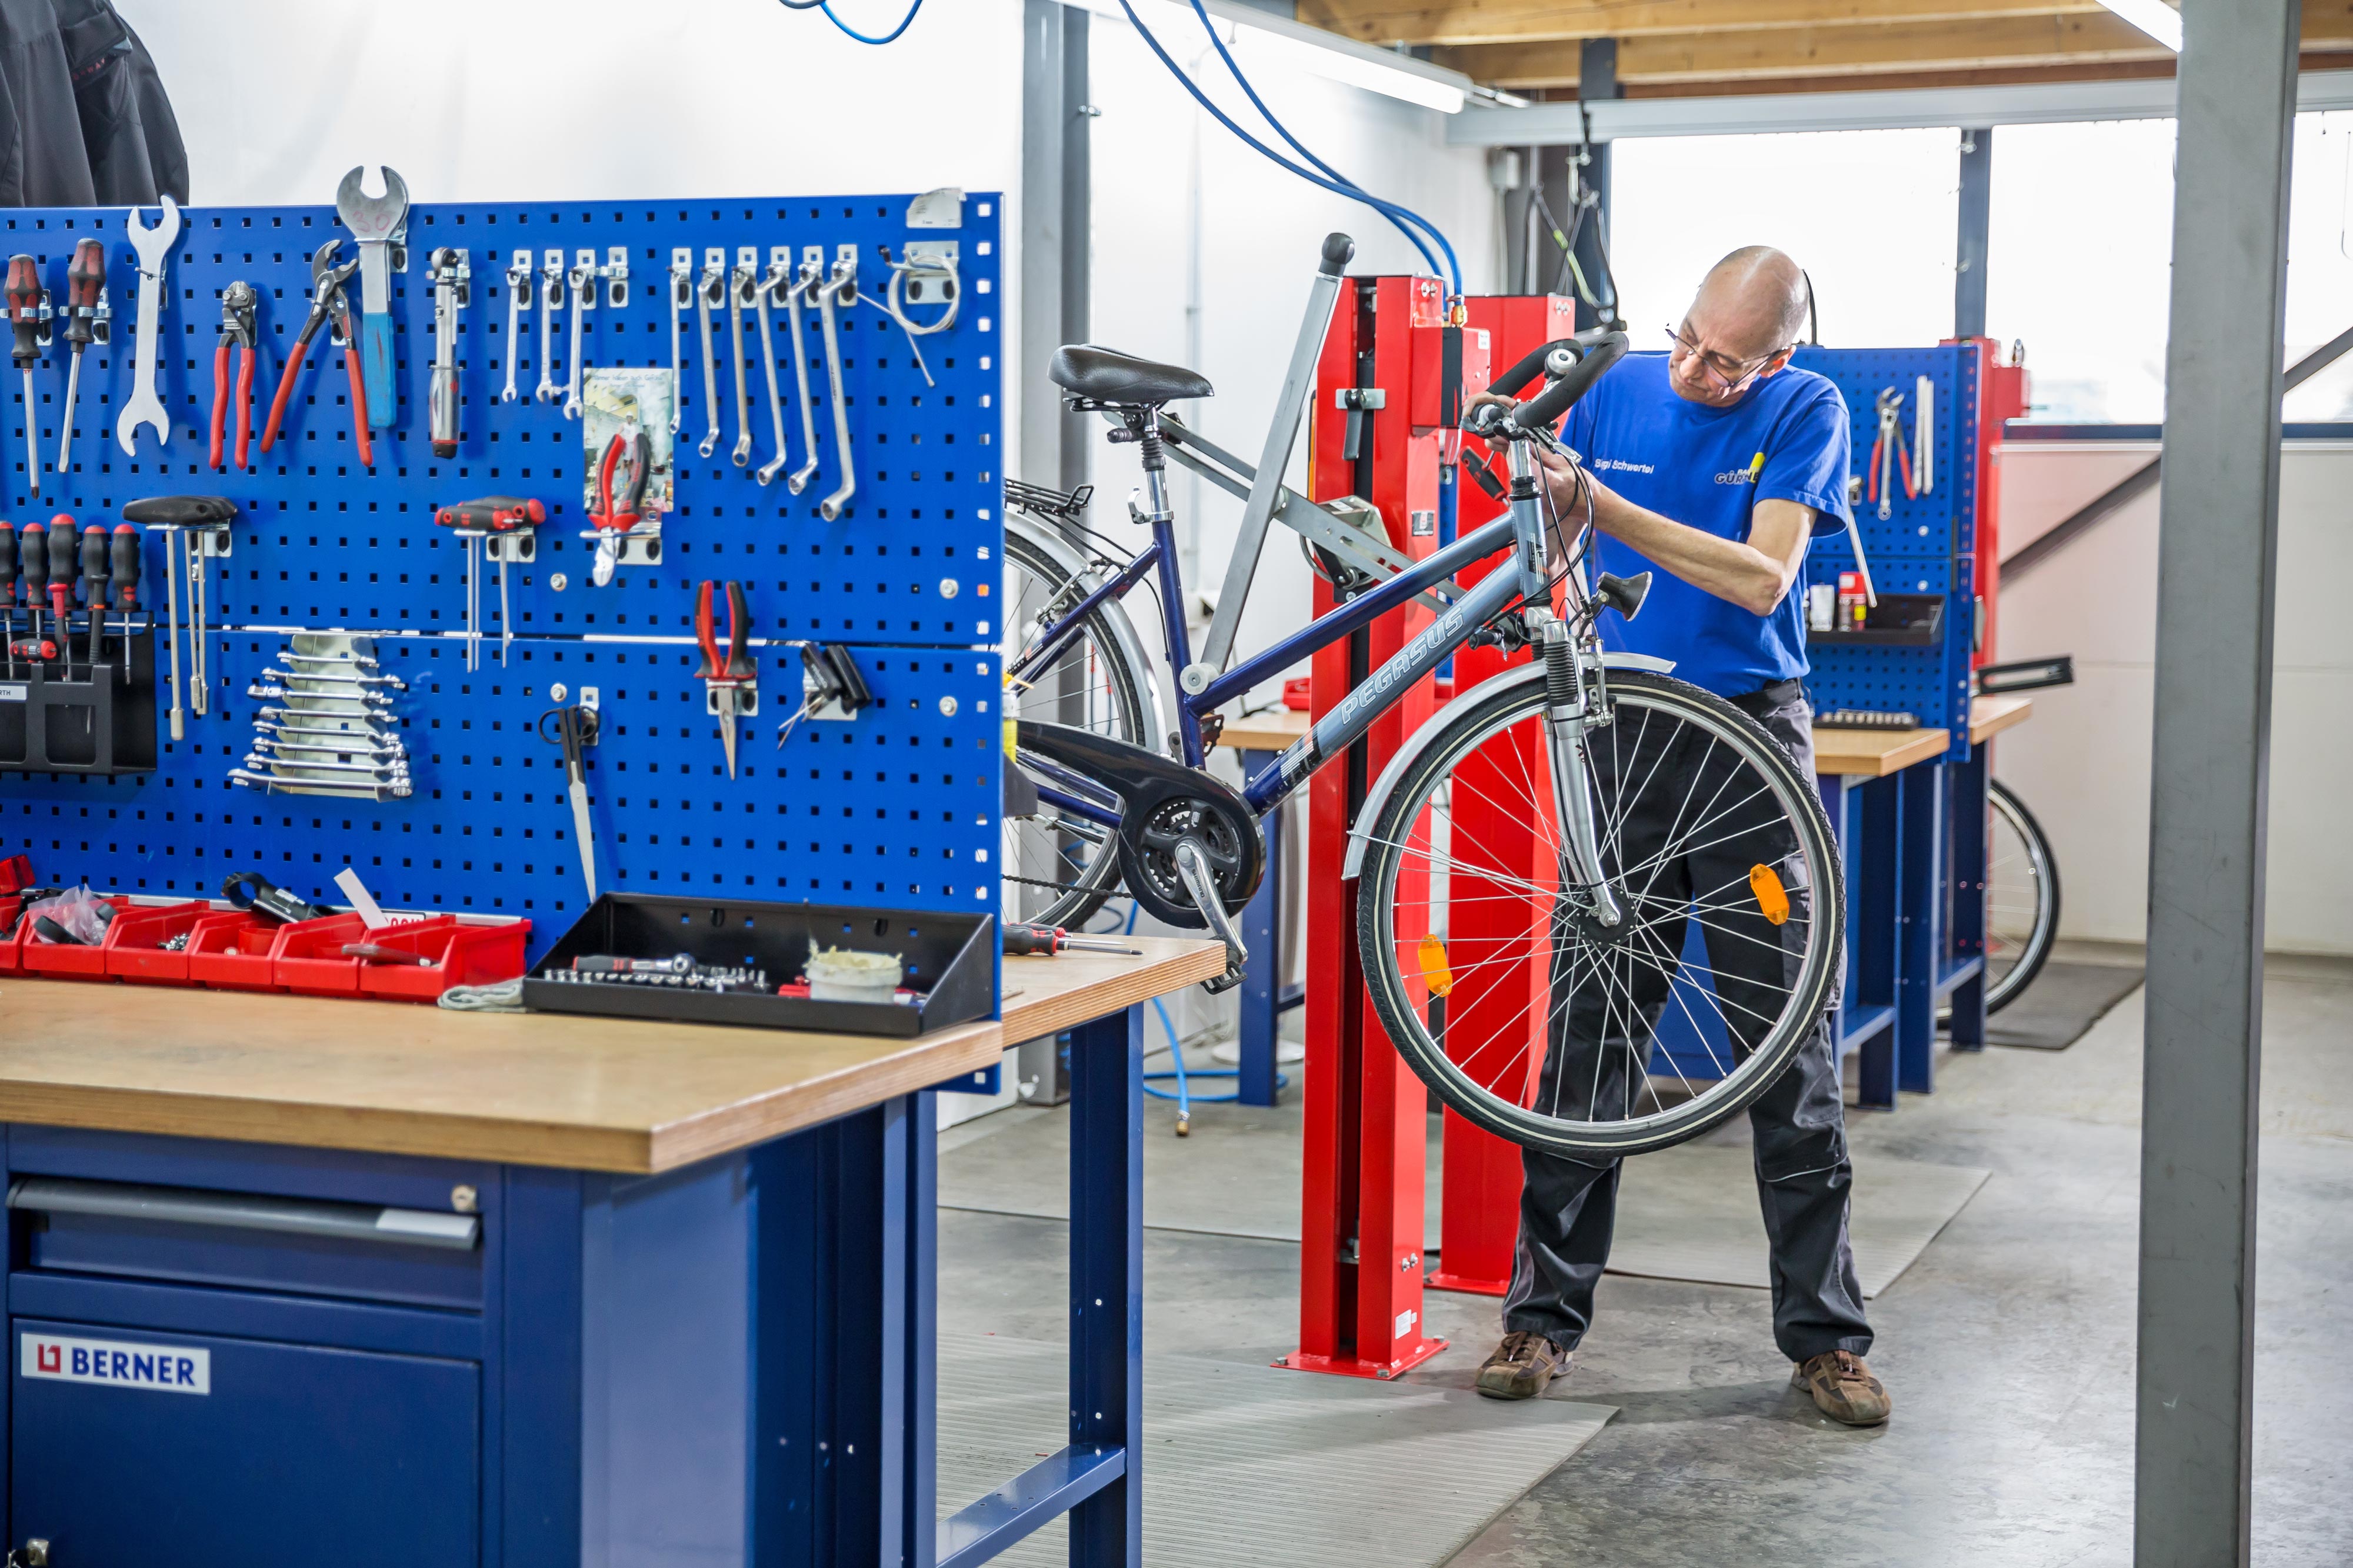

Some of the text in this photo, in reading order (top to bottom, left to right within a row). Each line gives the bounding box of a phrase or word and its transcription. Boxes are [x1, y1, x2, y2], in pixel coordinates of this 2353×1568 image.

[353, 211, 391, 233] 30
[1341, 607, 1464, 725] PEGASUS
[1191, 869, 1205, 898] SHIMANO
[71, 1347, 196, 1387] BERNER
